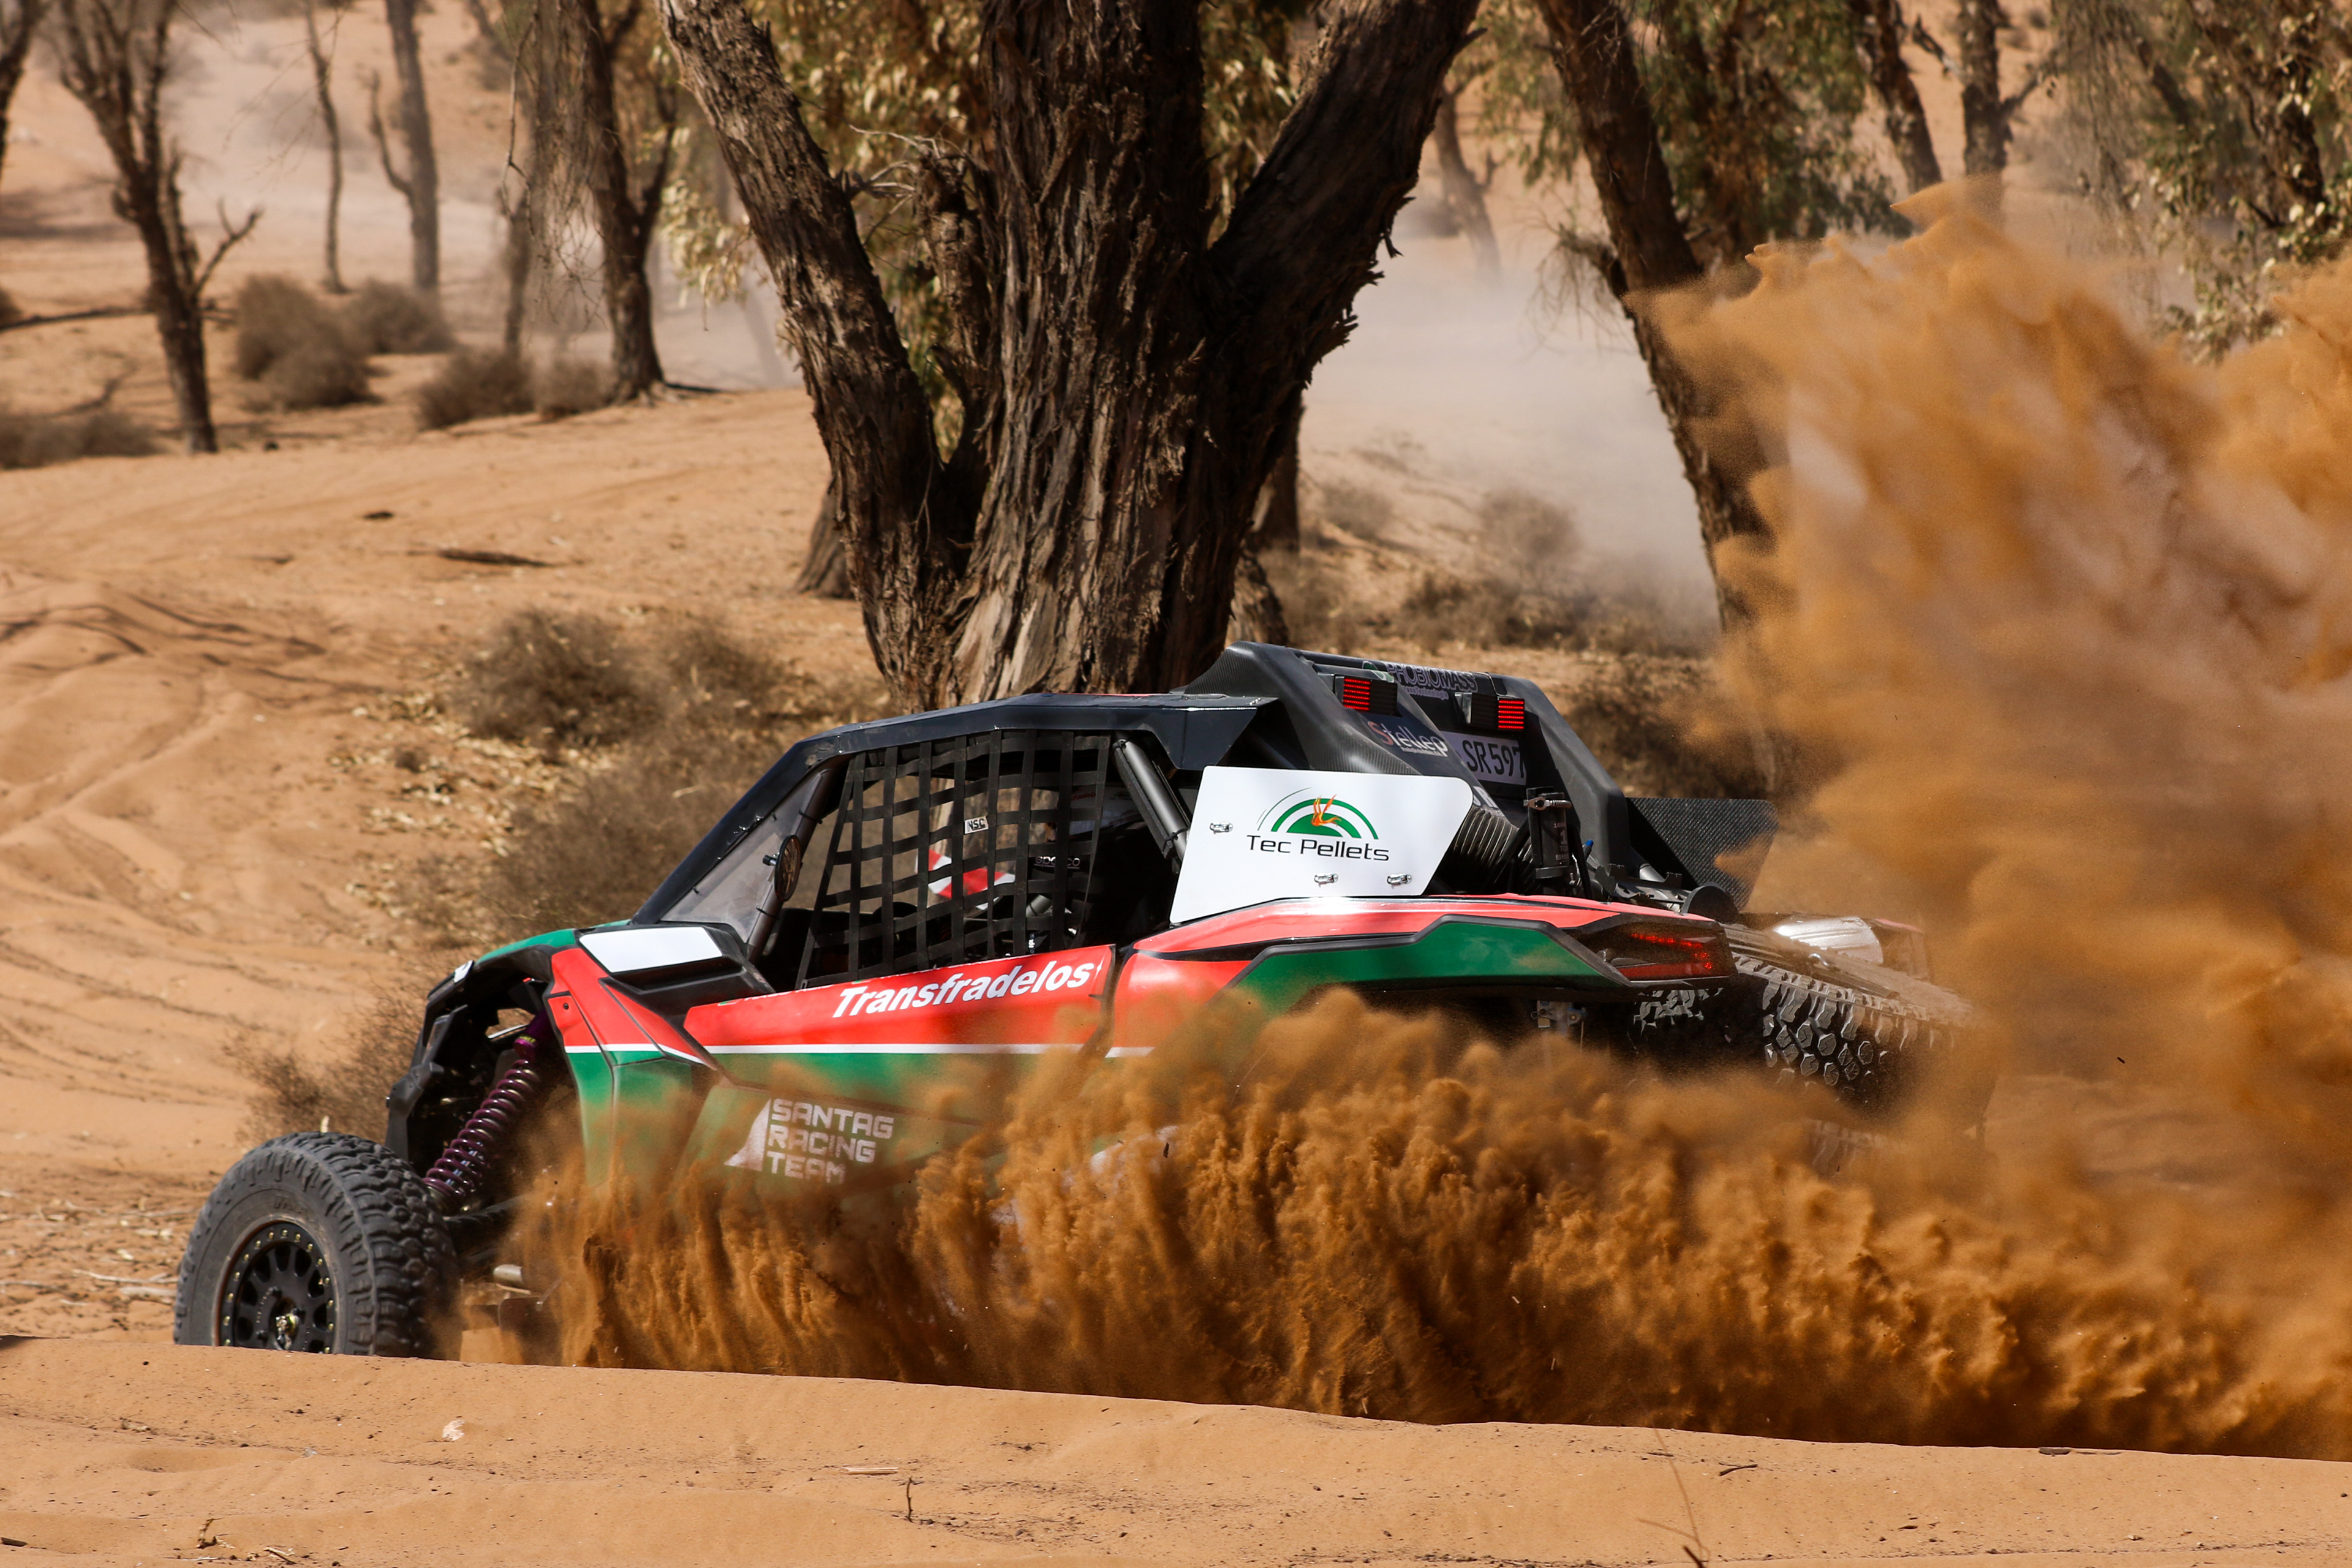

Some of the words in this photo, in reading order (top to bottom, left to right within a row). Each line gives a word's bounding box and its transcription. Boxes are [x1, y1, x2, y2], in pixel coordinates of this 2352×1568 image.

[1385, 663, 1477, 693] PROBIOMASS
[1247, 835, 1291, 853] Tec
[1300, 839, 1389, 861] Pellets
[832, 960, 1094, 1018] Transfradelos
[771, 1098, 894, 1139] SANTAG
[768, 1124, 876, 1163] RACING
[766, 1151, 845, 1183] TEAM
